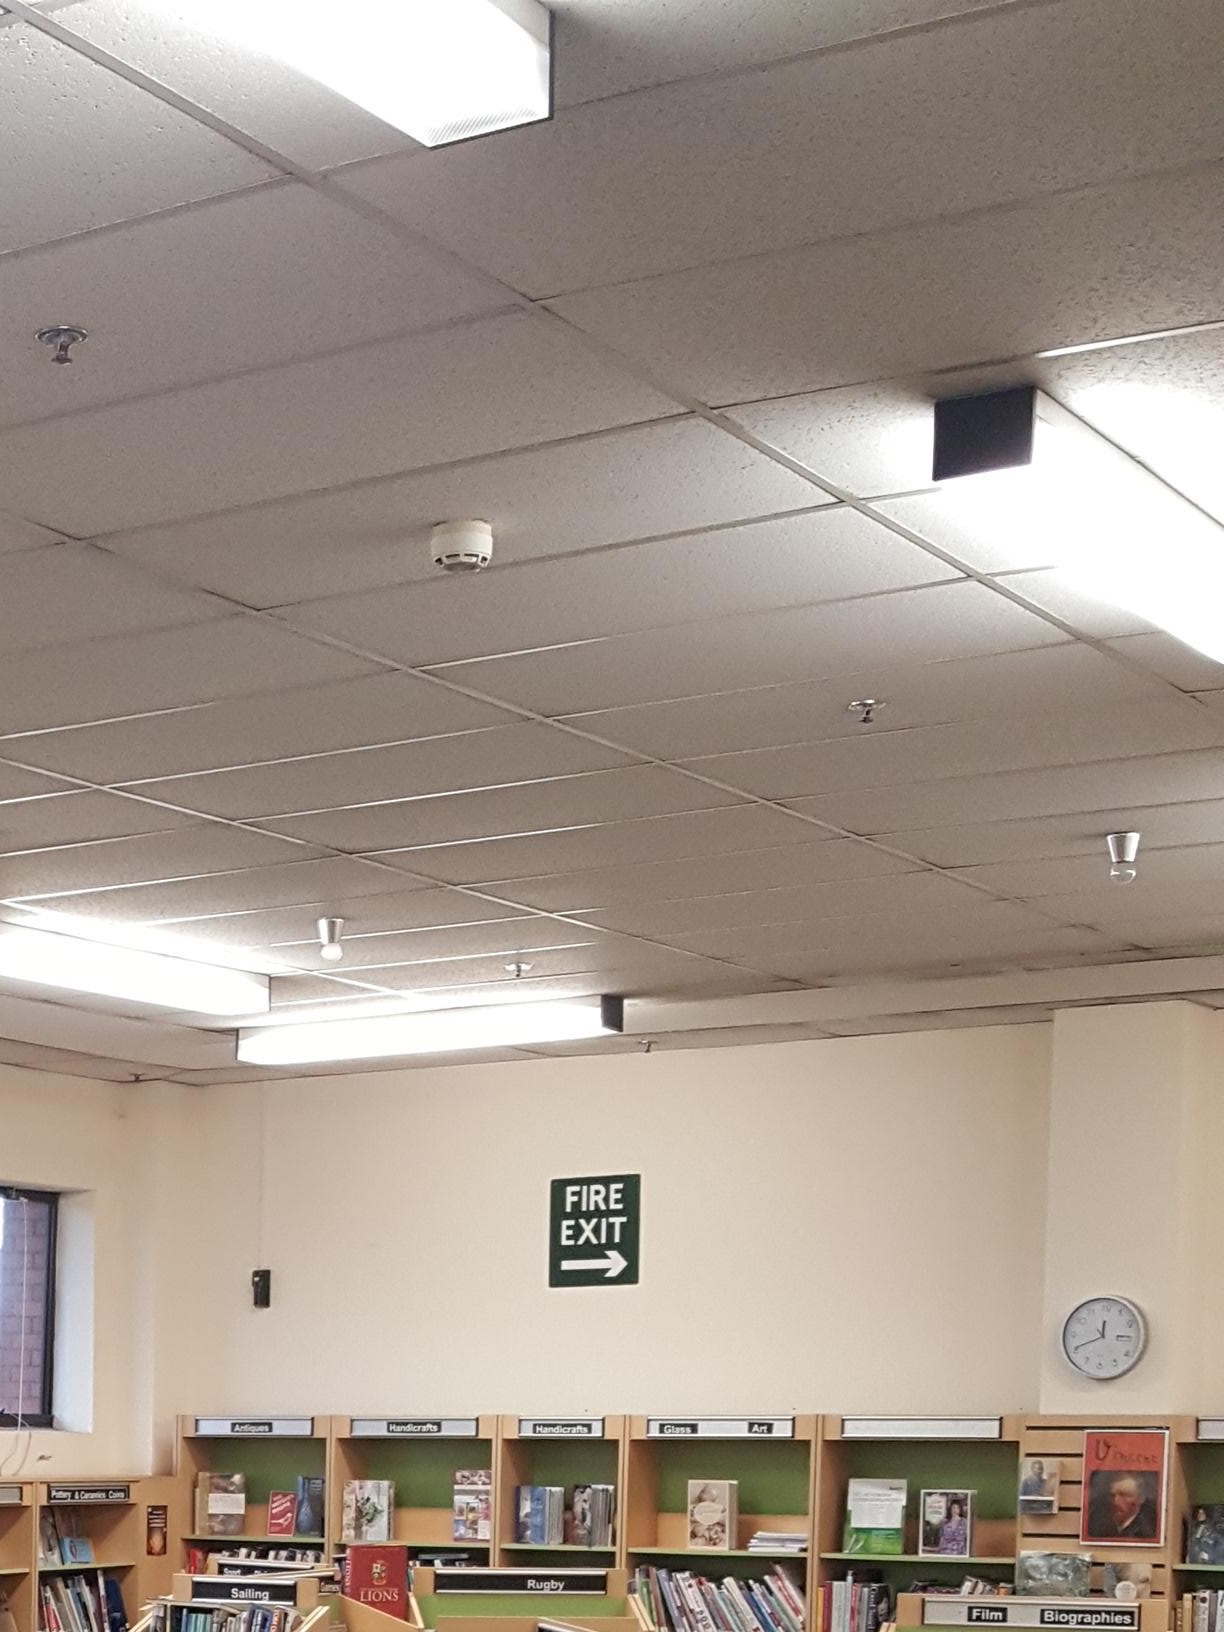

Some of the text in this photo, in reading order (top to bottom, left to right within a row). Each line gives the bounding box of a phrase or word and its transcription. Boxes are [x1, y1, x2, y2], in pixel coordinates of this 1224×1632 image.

[565, 1183, 624, 1212] FIRE
[561, 1217, 627, 1245] EXIT
[233, 1424, 269, 1433] Antiques
[389, 1423, 438, 1432] Handicrafts
[536, 1424, 589, 1434] Handicrafts
[663, 1423, 767, 1434] Glass Art
[1095, 1438, 1158, 1464] Vincent
[80, 1491, 106, 1499] Ceramics
[108, 1491, 124, 1499] Coins
[527, 1579, 565, 1592] Rugby
[231, 1588, 270, 1601] Sailing
[360, 1591, 399, 1602] LIONS
[972, 1607, 1132, 1626] Film Biographies
